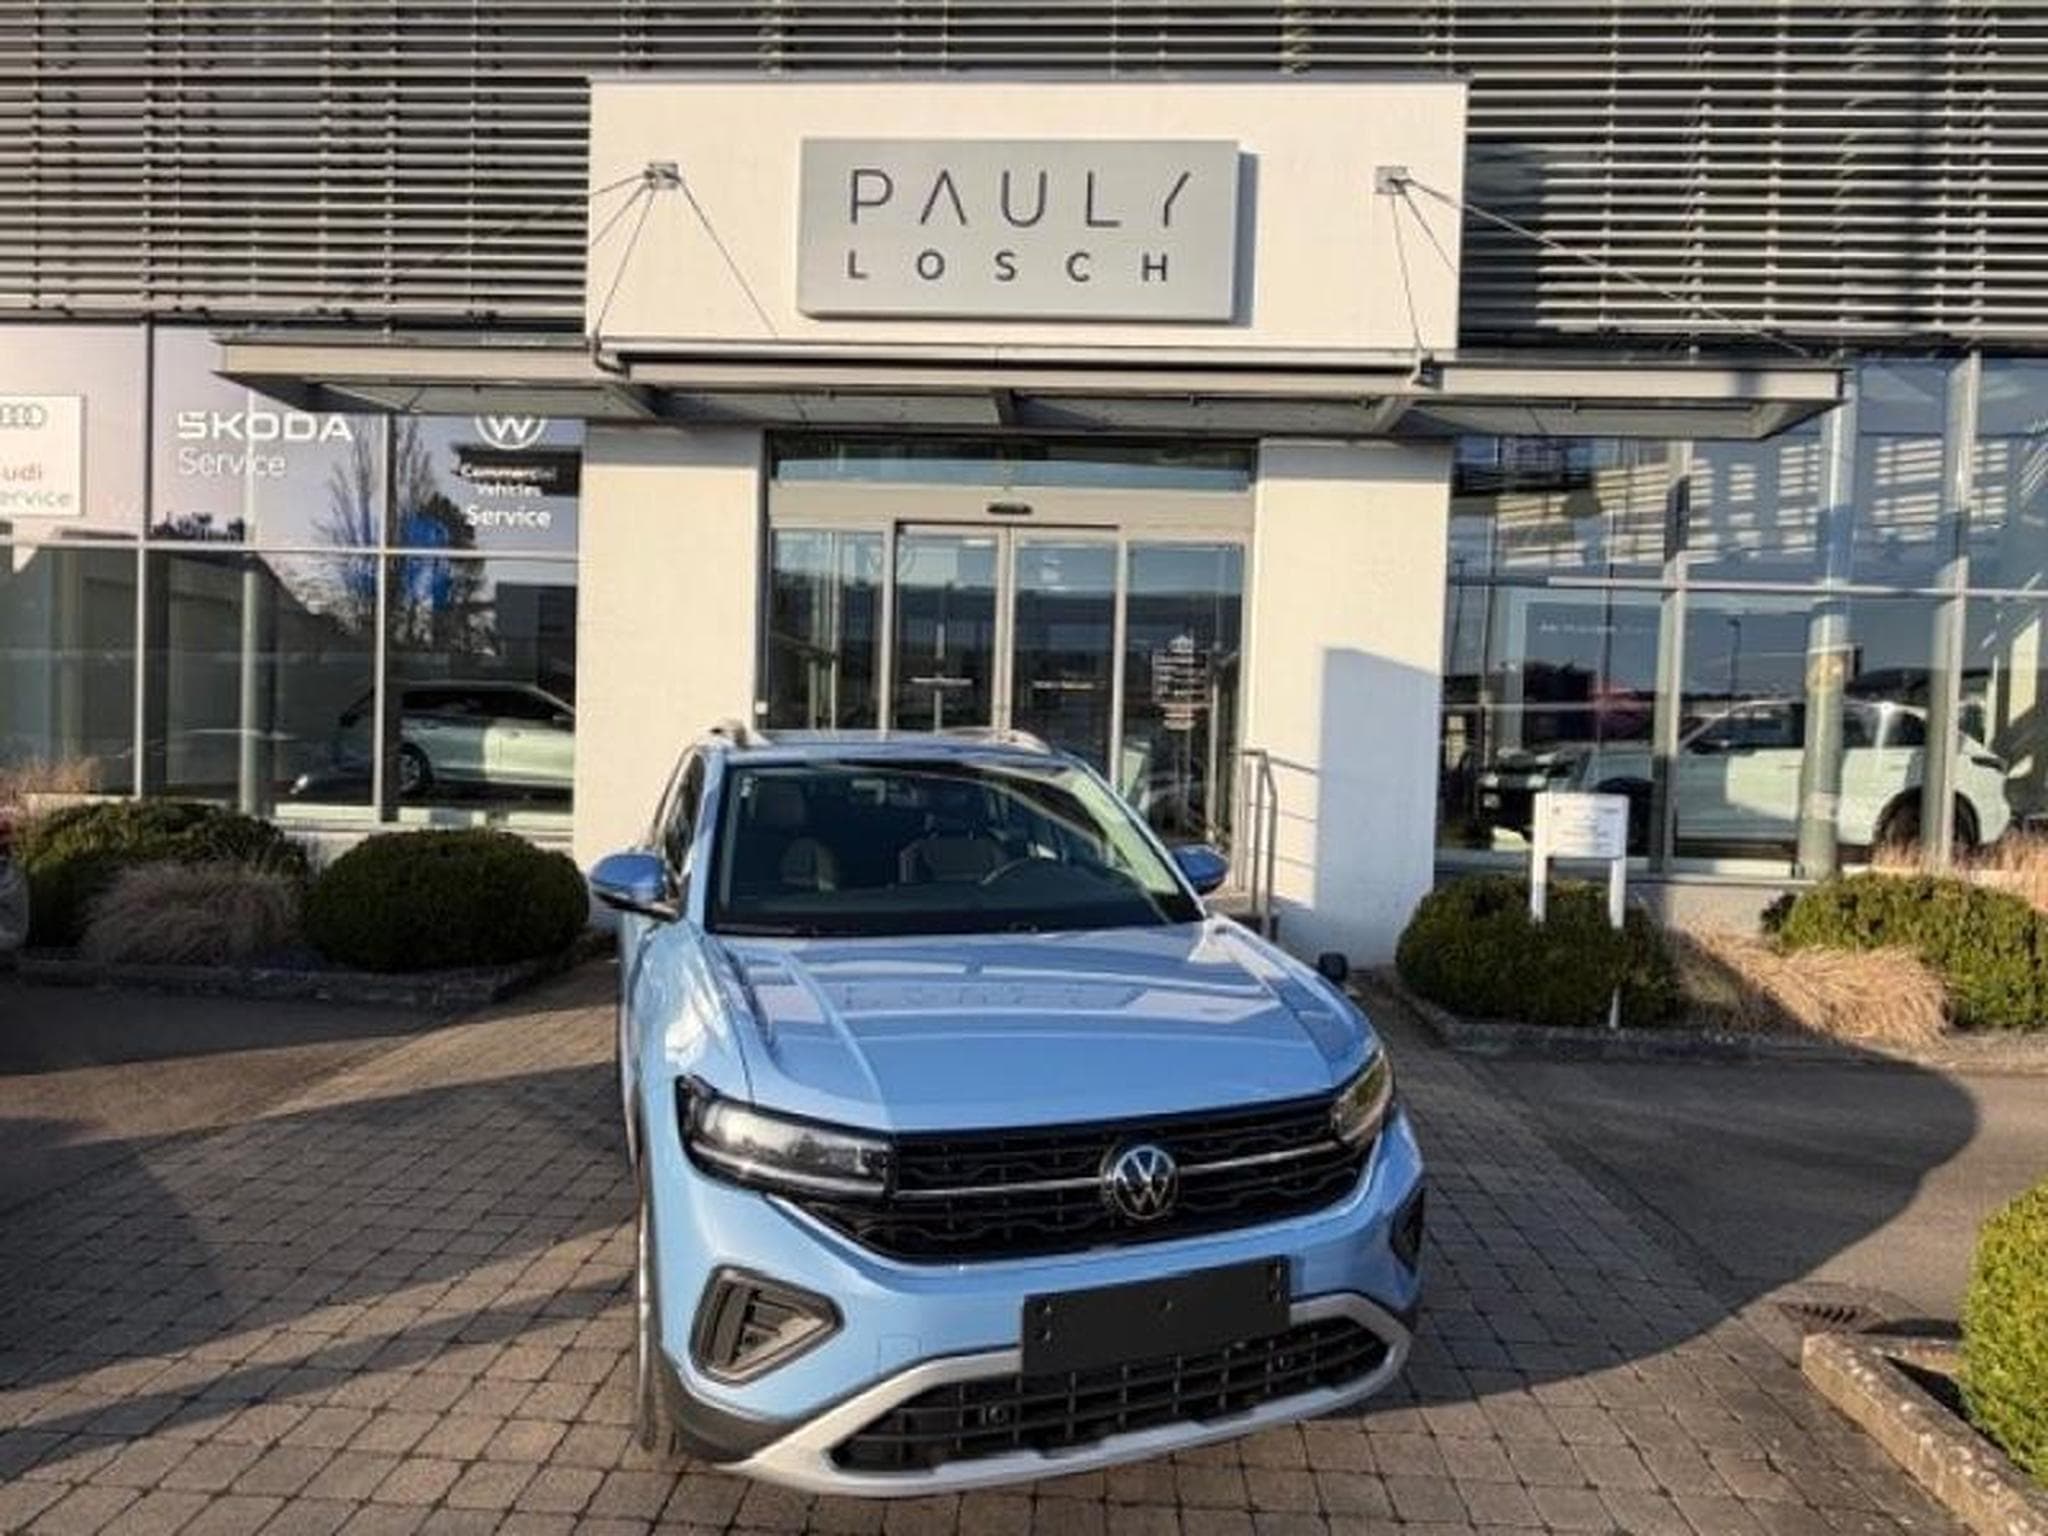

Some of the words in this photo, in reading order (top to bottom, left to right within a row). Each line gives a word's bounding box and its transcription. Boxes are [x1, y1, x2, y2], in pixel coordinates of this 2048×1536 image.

[850, 168, 1192, 228] PAULY
[847, 249, 1168, 283] LOSCH
[1, 461, 43, 482] udi
[178, 447, 286, 476] Service
[0, 490, 71, 508] ervice
[465, 504, 552, 528] Service
